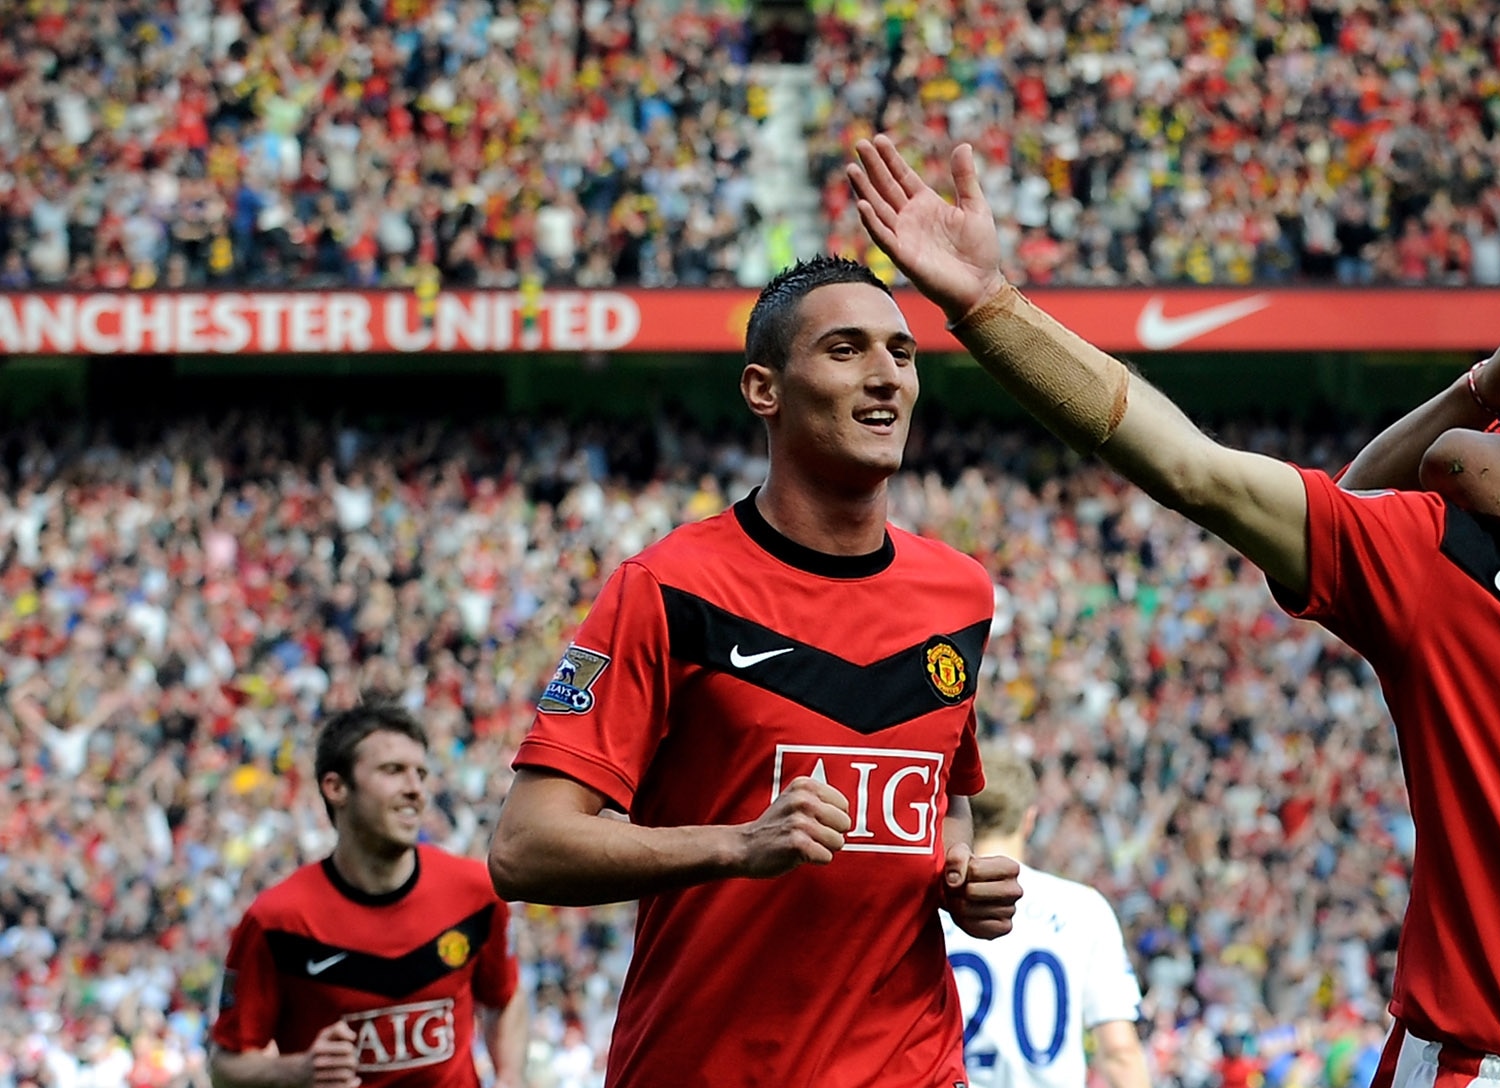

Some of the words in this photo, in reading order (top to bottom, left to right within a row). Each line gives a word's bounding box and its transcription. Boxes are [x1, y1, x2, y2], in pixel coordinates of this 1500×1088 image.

[384, 293, 642, 354] UNITED
[806, 757, 931, 843] IG
[358, 1008, 449, 1065] AIG
[947, 949, 1068, 1067] 20
